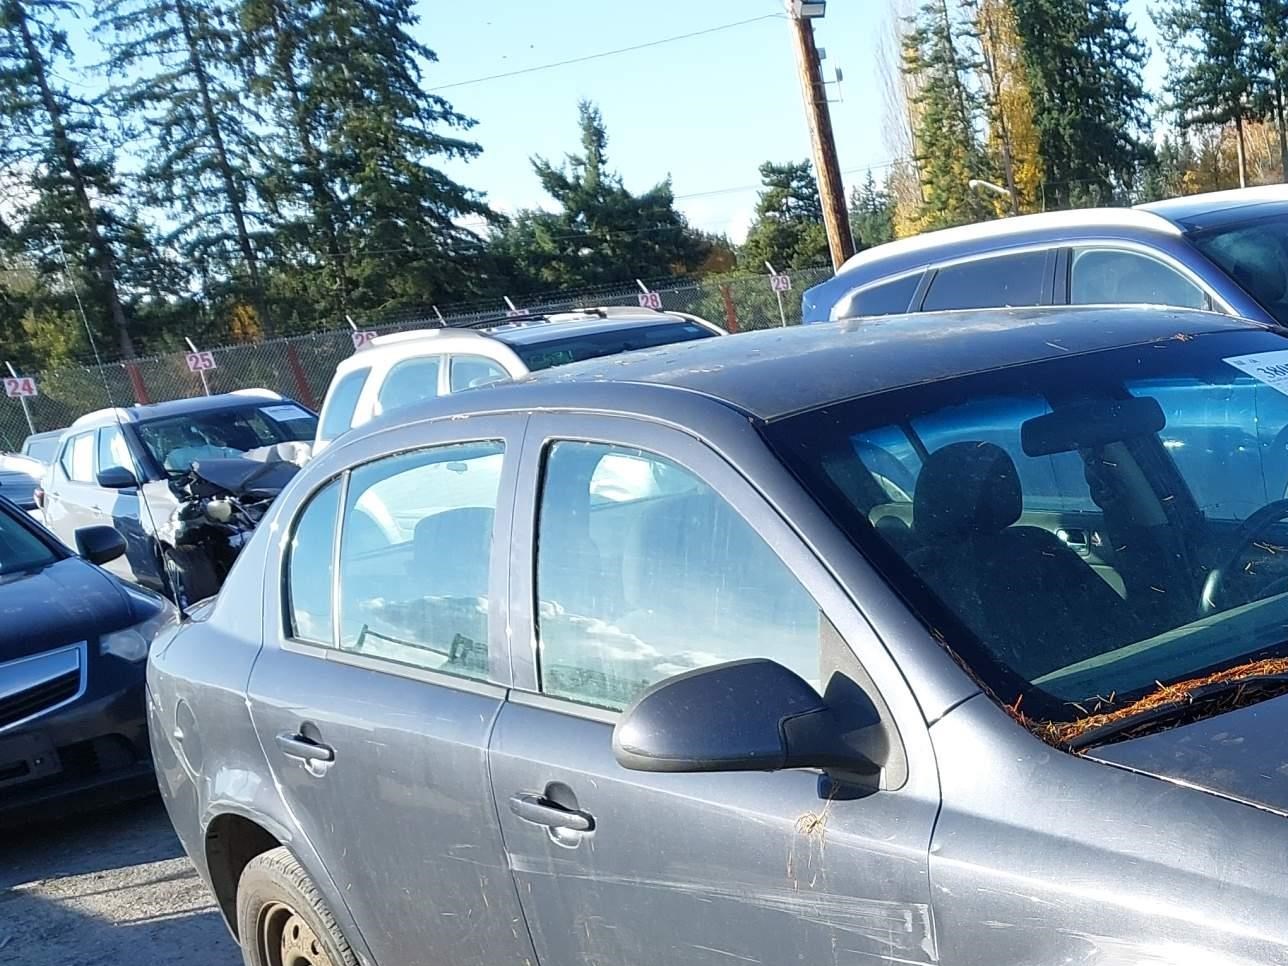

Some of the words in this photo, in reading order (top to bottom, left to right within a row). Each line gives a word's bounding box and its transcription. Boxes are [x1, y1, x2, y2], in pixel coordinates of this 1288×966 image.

[774, 276, 790, 289] 29
[641, 293, 660, 308] 28
[188, 354, 214, 370] 25
[7, 378, 34, 396] 24
